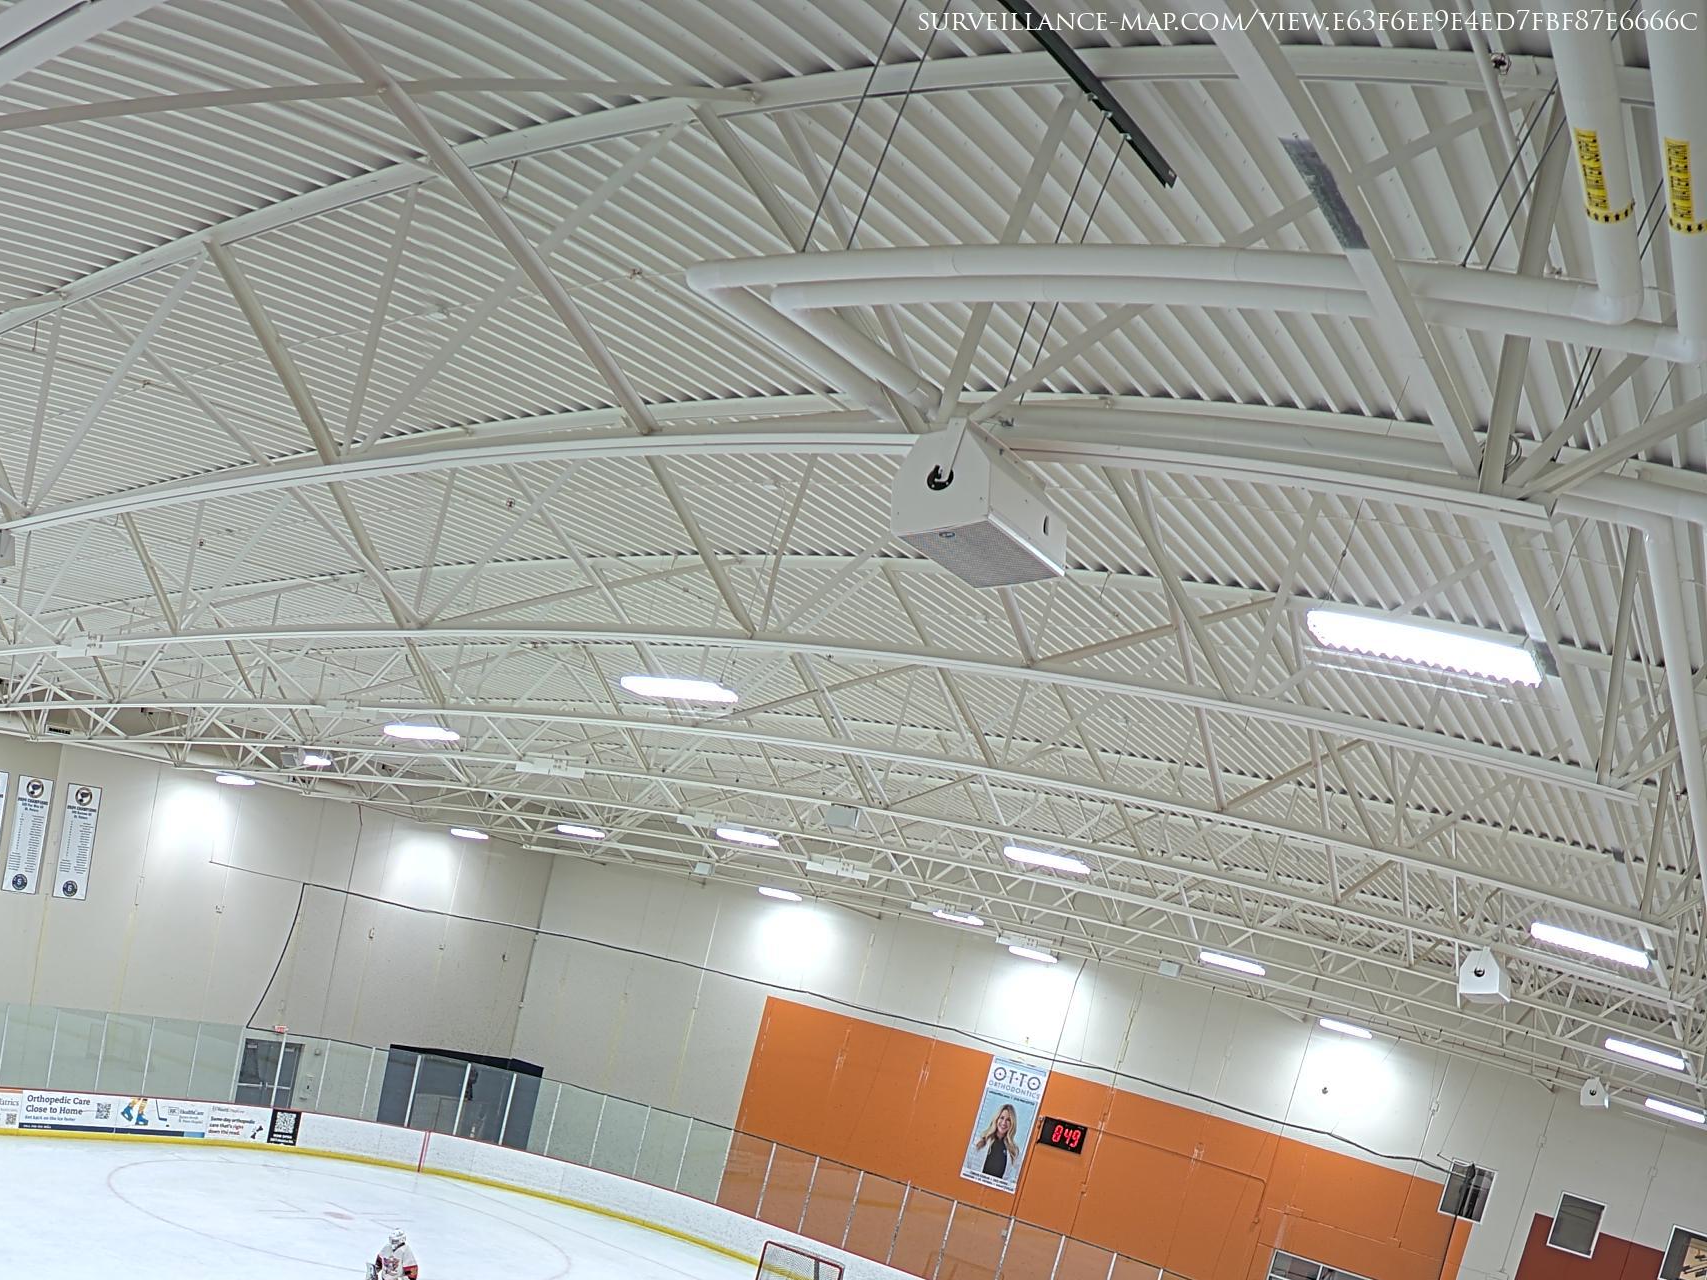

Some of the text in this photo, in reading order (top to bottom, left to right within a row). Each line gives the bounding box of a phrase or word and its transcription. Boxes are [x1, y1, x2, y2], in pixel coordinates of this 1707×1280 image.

[994, 1067, 1041, 1091] OTTO
[989, 1080, 1041, 1100] ORTHODONTICS
[27, 1094, 71, 1105] Orthopedic
[26, 1105, 48, 1113] Close
[49, 1106, 58, 1114] to
[59, 1107, 83, 1115] Home
